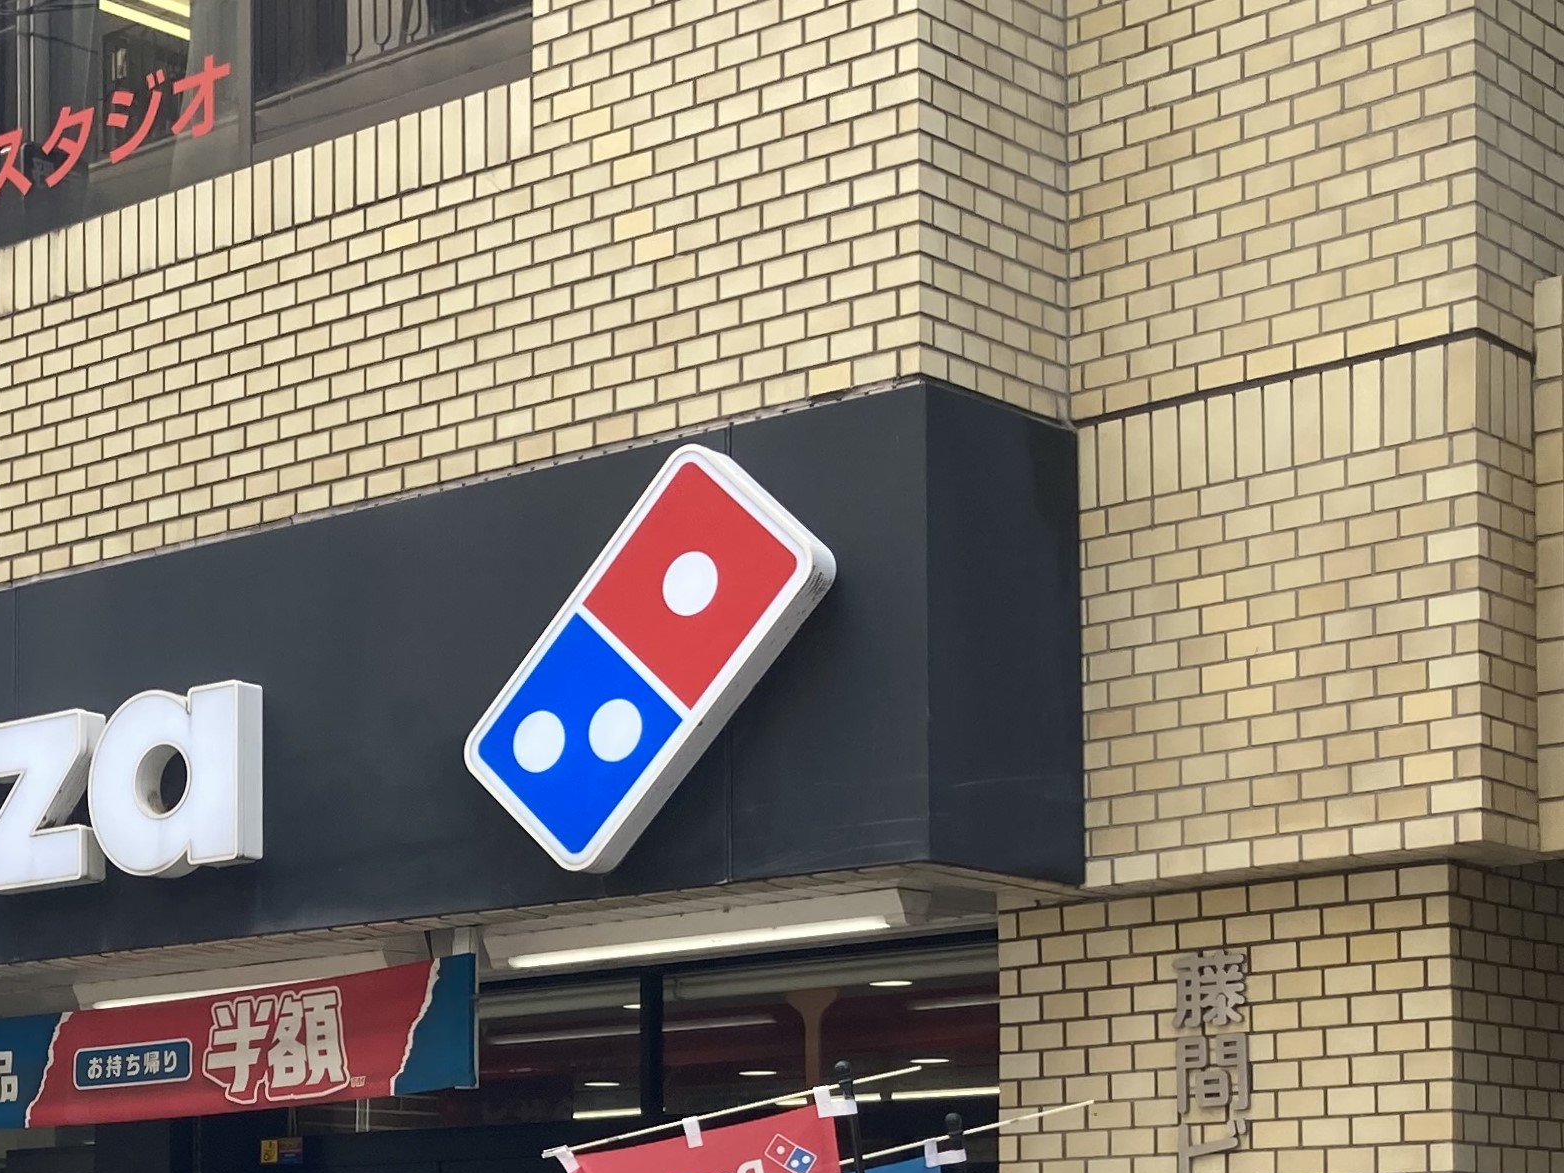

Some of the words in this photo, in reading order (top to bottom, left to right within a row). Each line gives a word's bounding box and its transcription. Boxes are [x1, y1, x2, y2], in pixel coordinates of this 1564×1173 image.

[86, 1049, 178, 1081] お持ち帰り
[205, 988, 347, 1098] 半額
